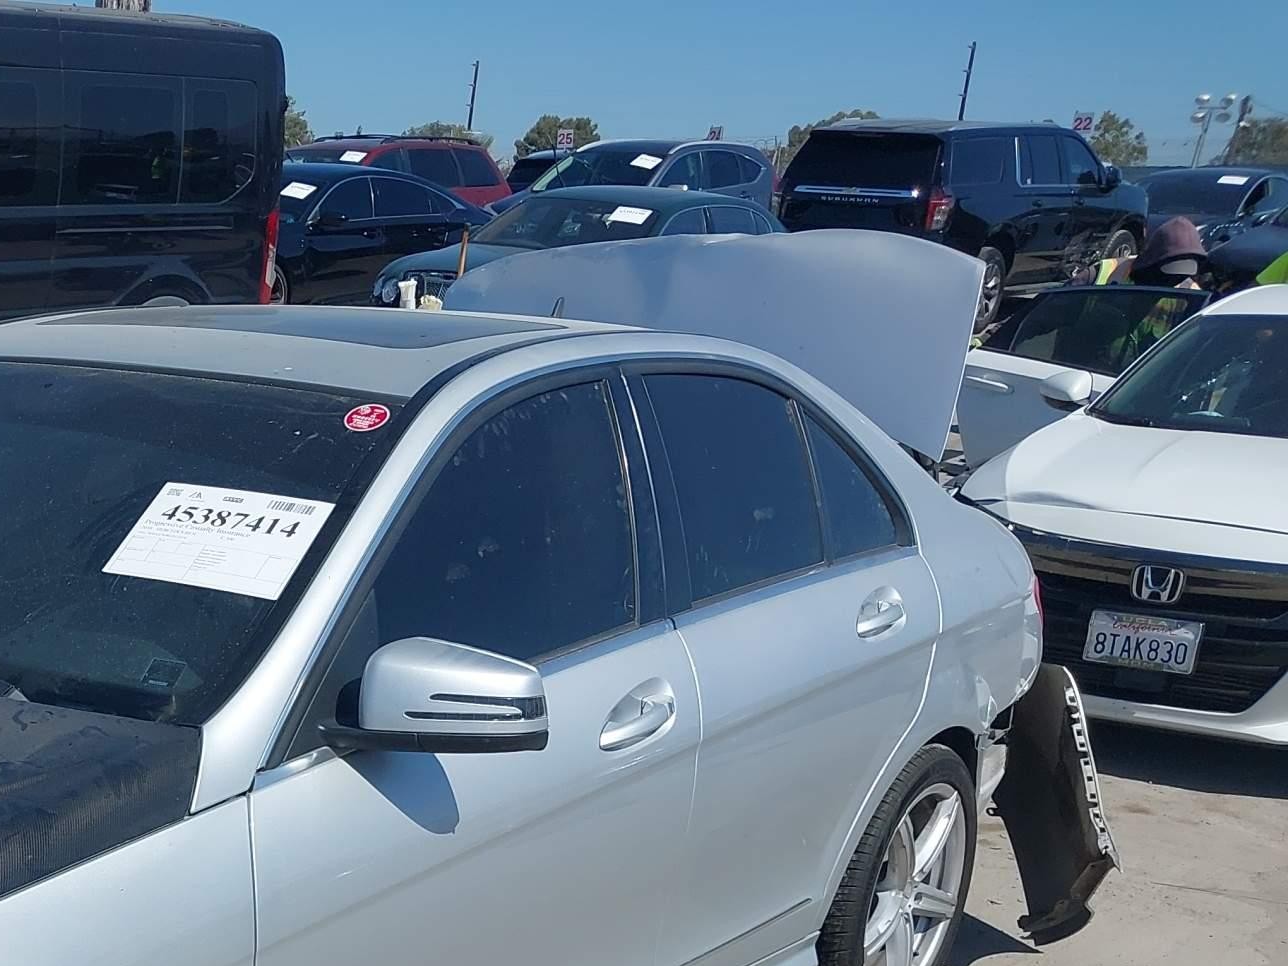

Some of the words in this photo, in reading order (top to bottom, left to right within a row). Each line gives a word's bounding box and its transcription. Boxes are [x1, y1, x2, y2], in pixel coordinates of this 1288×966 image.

[1073, 117, 1093, 130] 22
[558, 132, 573, 145] 25
[161, 504, 301, 538] 45387414
[1094, 632, 1188, 665] 8TAK830
